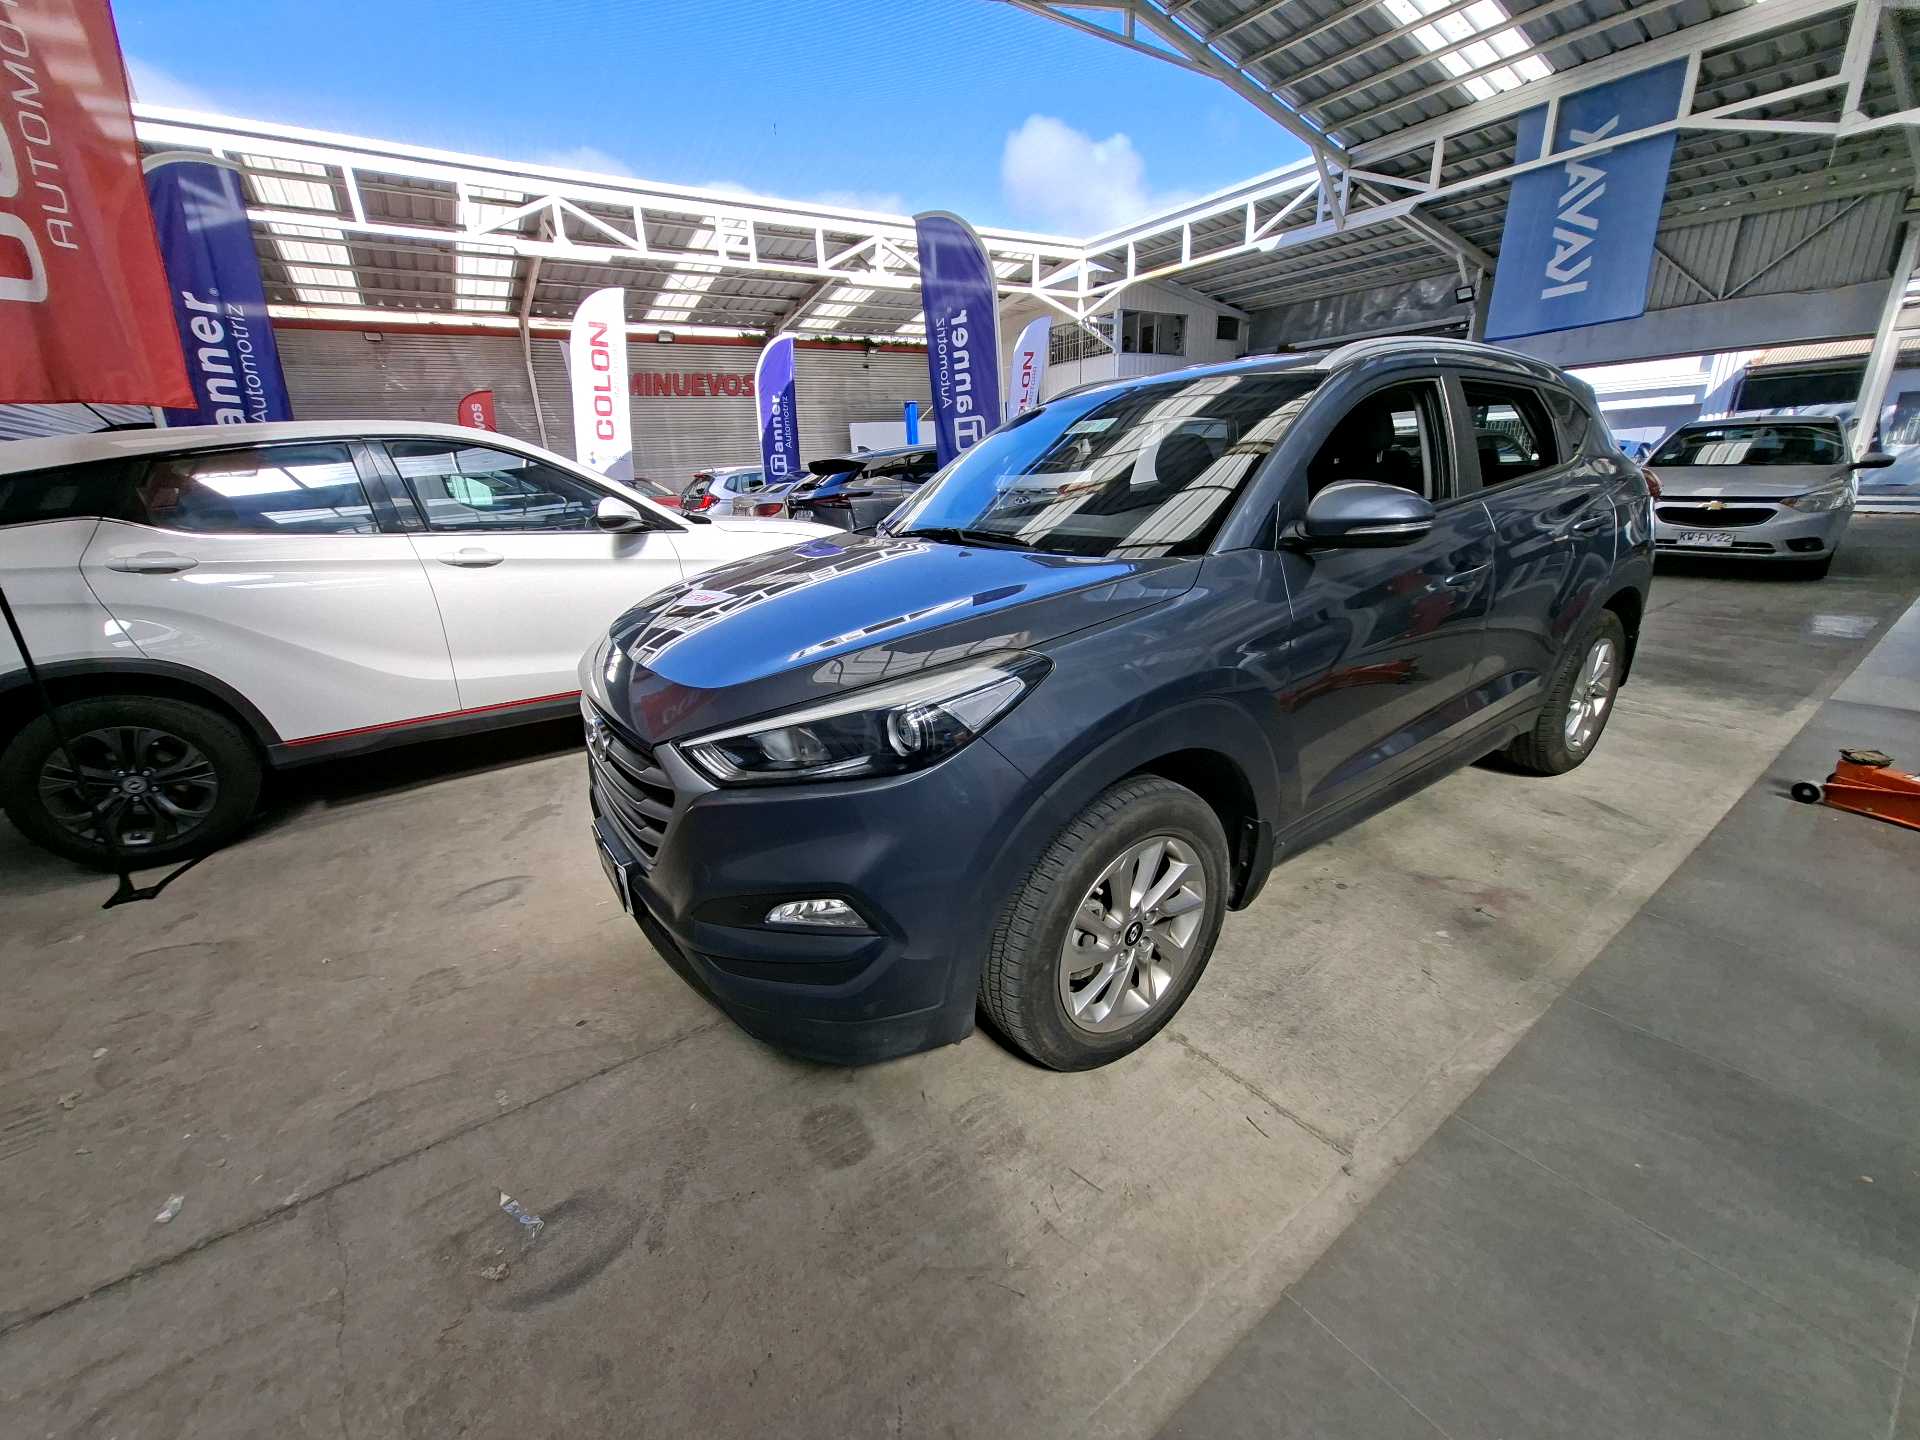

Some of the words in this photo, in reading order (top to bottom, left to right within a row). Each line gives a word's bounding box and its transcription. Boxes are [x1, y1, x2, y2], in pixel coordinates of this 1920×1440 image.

[0, 0, 79, 250] AUTOMO
[225, 303, 269, 423] Automotriz
[588, 321, 614, 440] COLON
[782, 395, 792, 448] Automotriz
